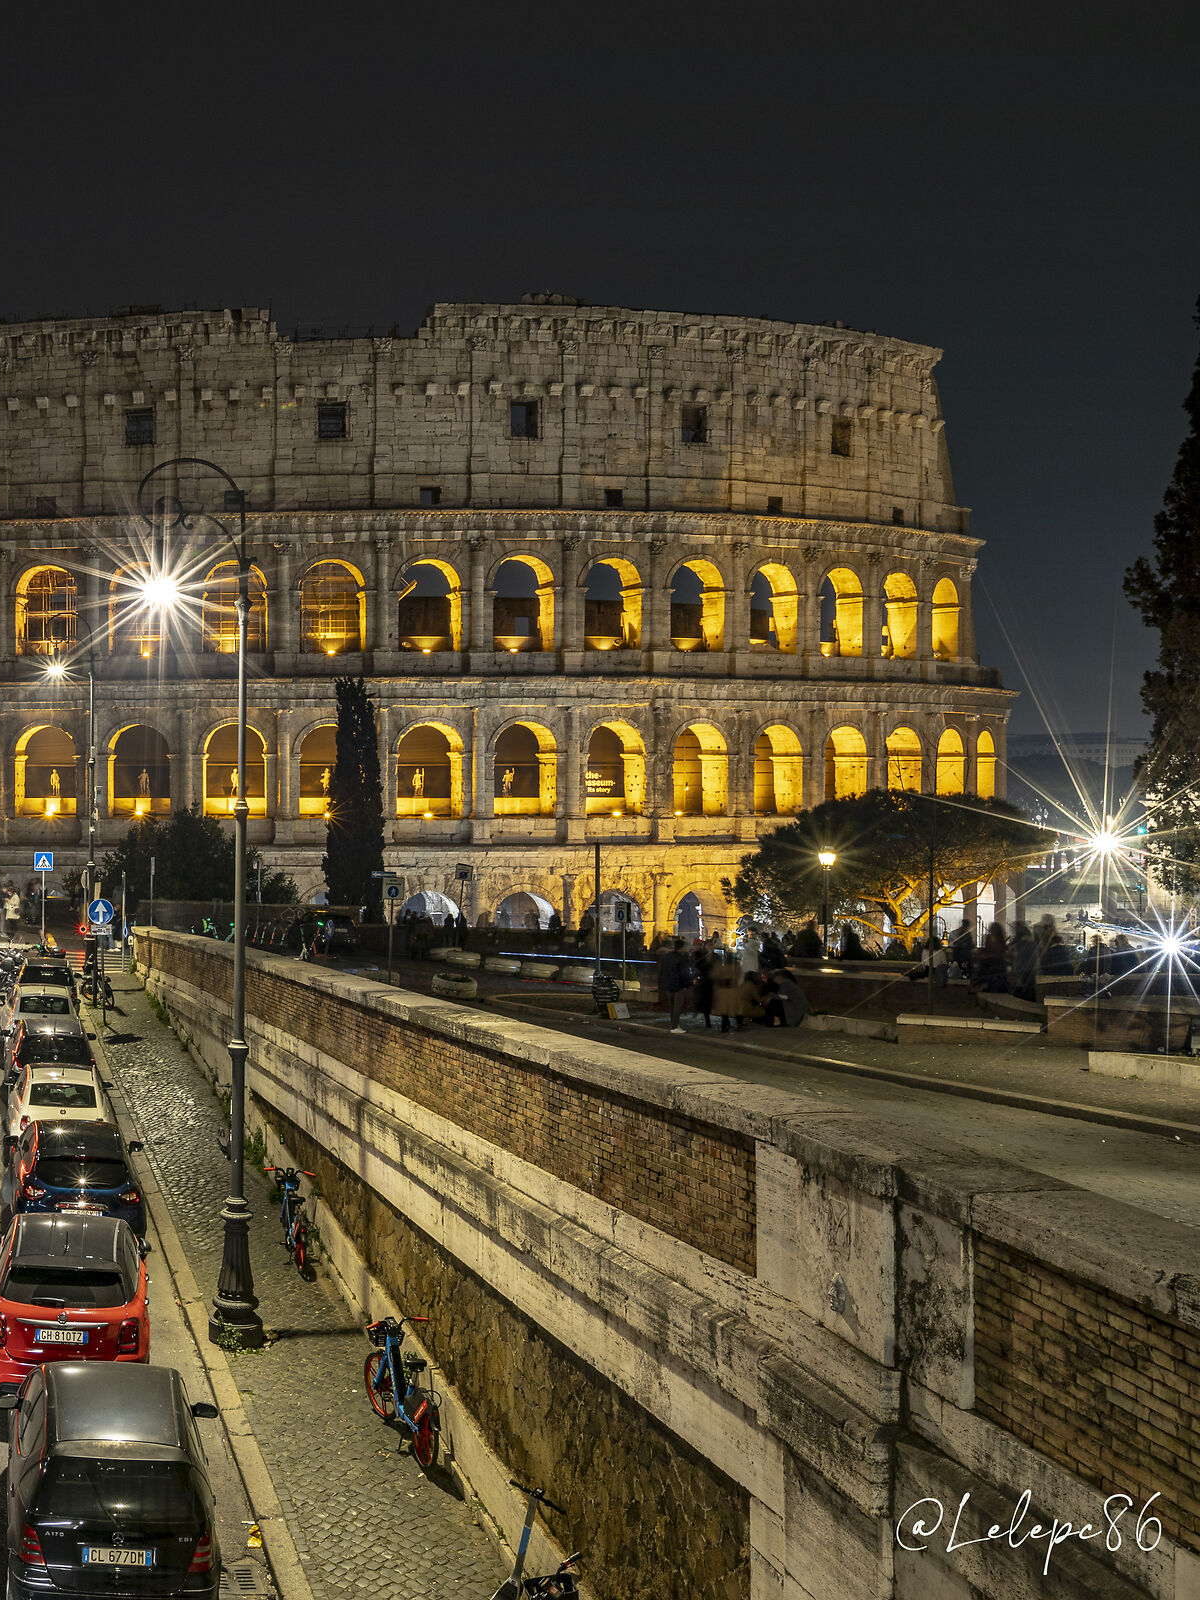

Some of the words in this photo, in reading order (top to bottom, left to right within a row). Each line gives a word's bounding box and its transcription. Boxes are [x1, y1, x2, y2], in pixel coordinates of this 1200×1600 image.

[596, 786, 612, 794] story
[91, 1549, 104, 1562] CL
[108, 1550, 144, 1564] 677DM
